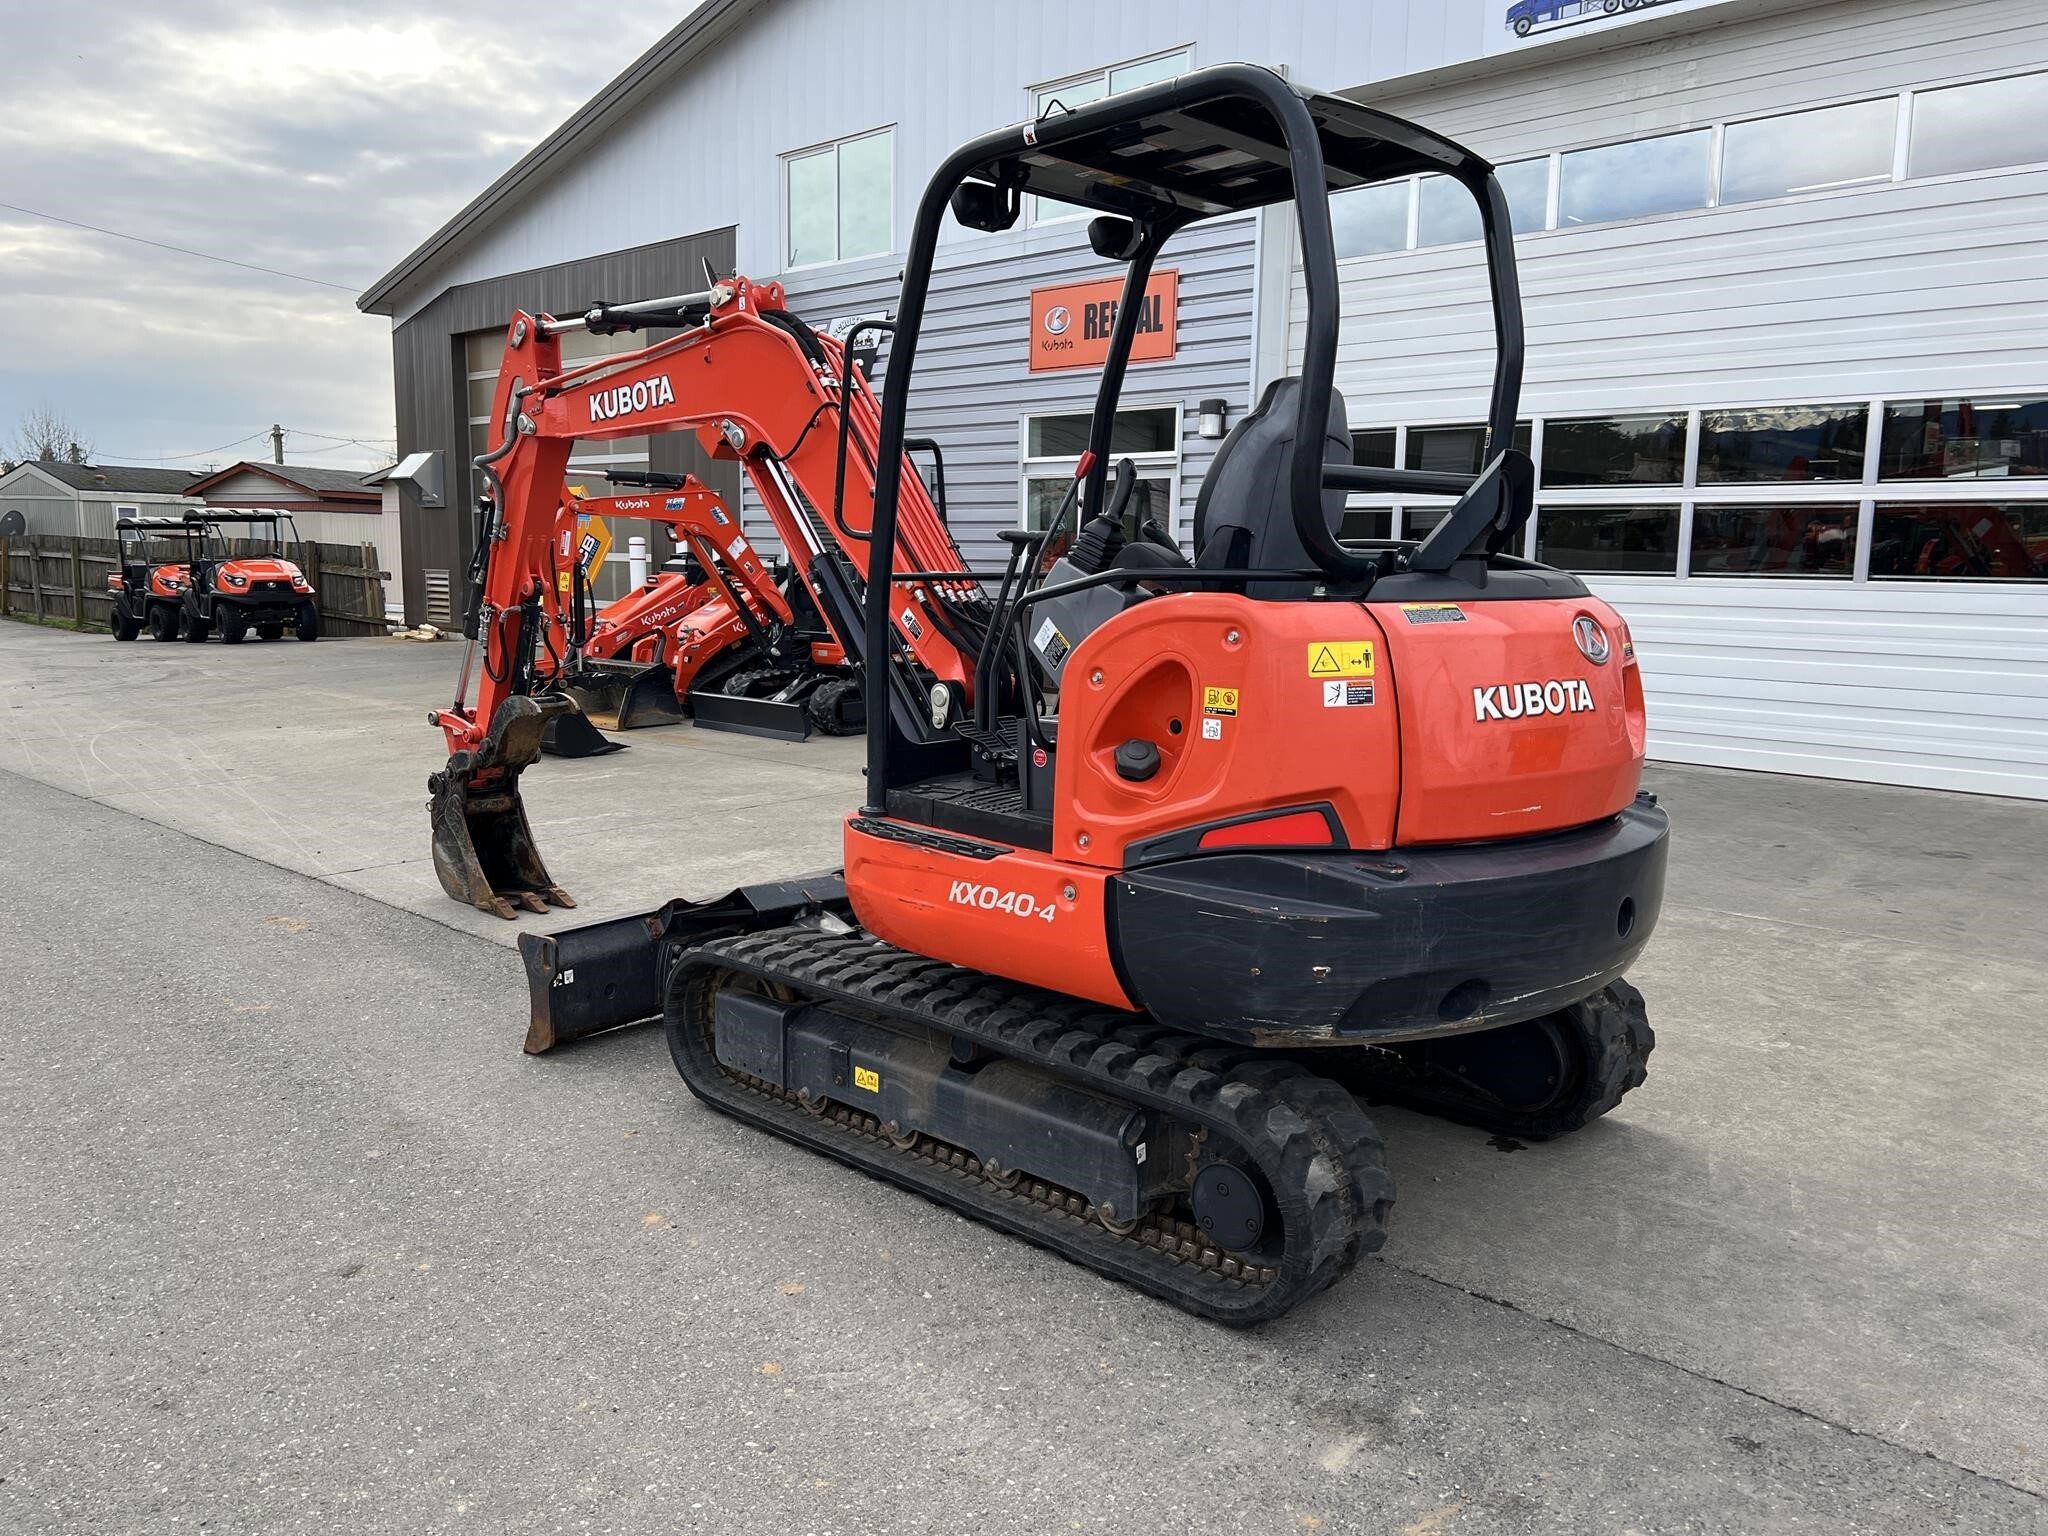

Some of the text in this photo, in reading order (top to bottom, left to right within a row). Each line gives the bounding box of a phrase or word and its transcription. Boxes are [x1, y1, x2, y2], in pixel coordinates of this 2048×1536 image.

[1041, 339, 1074, 351] Kubota
[589, 375, 675, 422] KUBOTA
[615, 499, 650, 510] Kubota
[640, 605, 677, 626] Kubota
[1473, 679, 1595, 721] KUBOTA
[948, 880, 1056, 923] KX040-4
